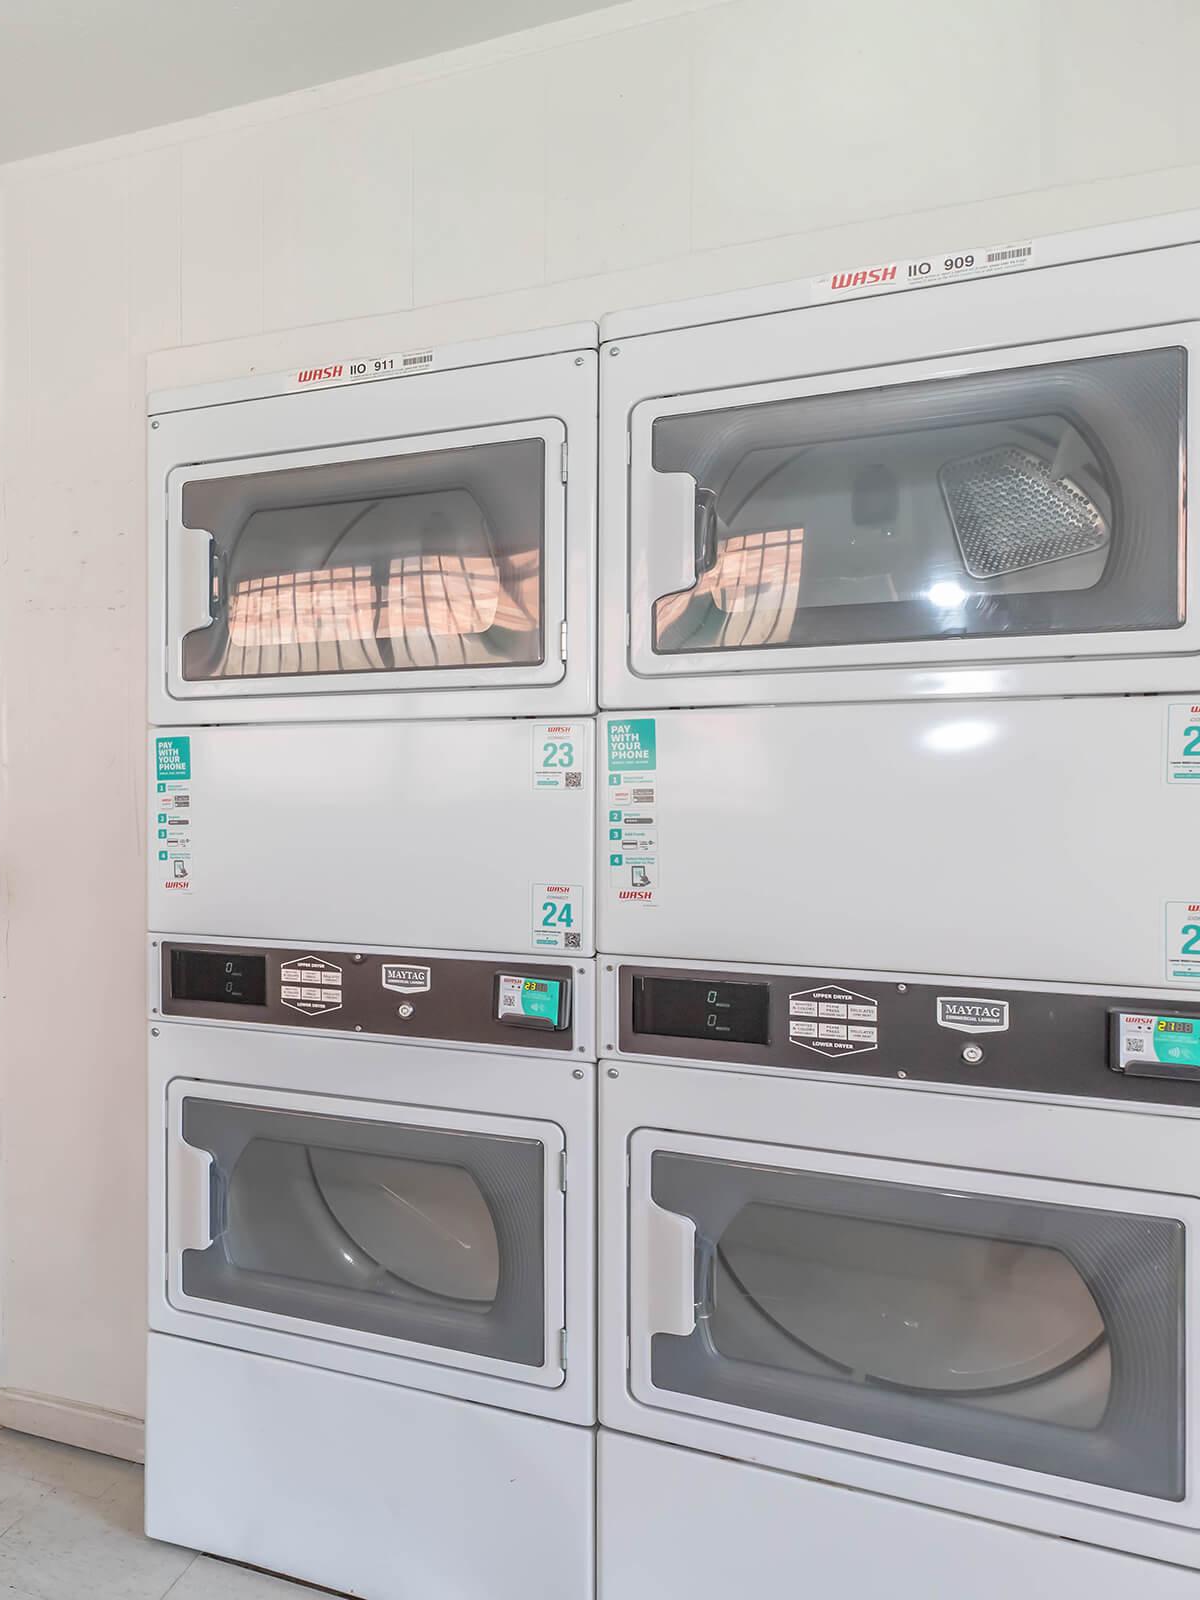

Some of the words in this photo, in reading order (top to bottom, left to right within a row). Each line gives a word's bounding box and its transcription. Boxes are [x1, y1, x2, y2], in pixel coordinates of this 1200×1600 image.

[831, 266, 897, 289] WASH
[944, 255, 974, 271] 909
[298, 365, 343, 383] WASH
[374, 359, 394, 371] 911
[611, 725, 631, 733] PAY
[611, 733, 639, 742] WITH
[611, 742, 641, 750] YOUR
[543, 742, 574, 767] 23
[612, 750, 649, 759] PHONE
[619, 891, 652, 899] WASH
[542, 902, 574, 928] 24
[387, 970, 425, 980] MAYTAG
[525, 982, 536, 990] 23
[707, 991, 717, 1003] 0
[945, 1004, 1000, 1017] MAYTAG
[707, 1014, 717, 1026] 0
